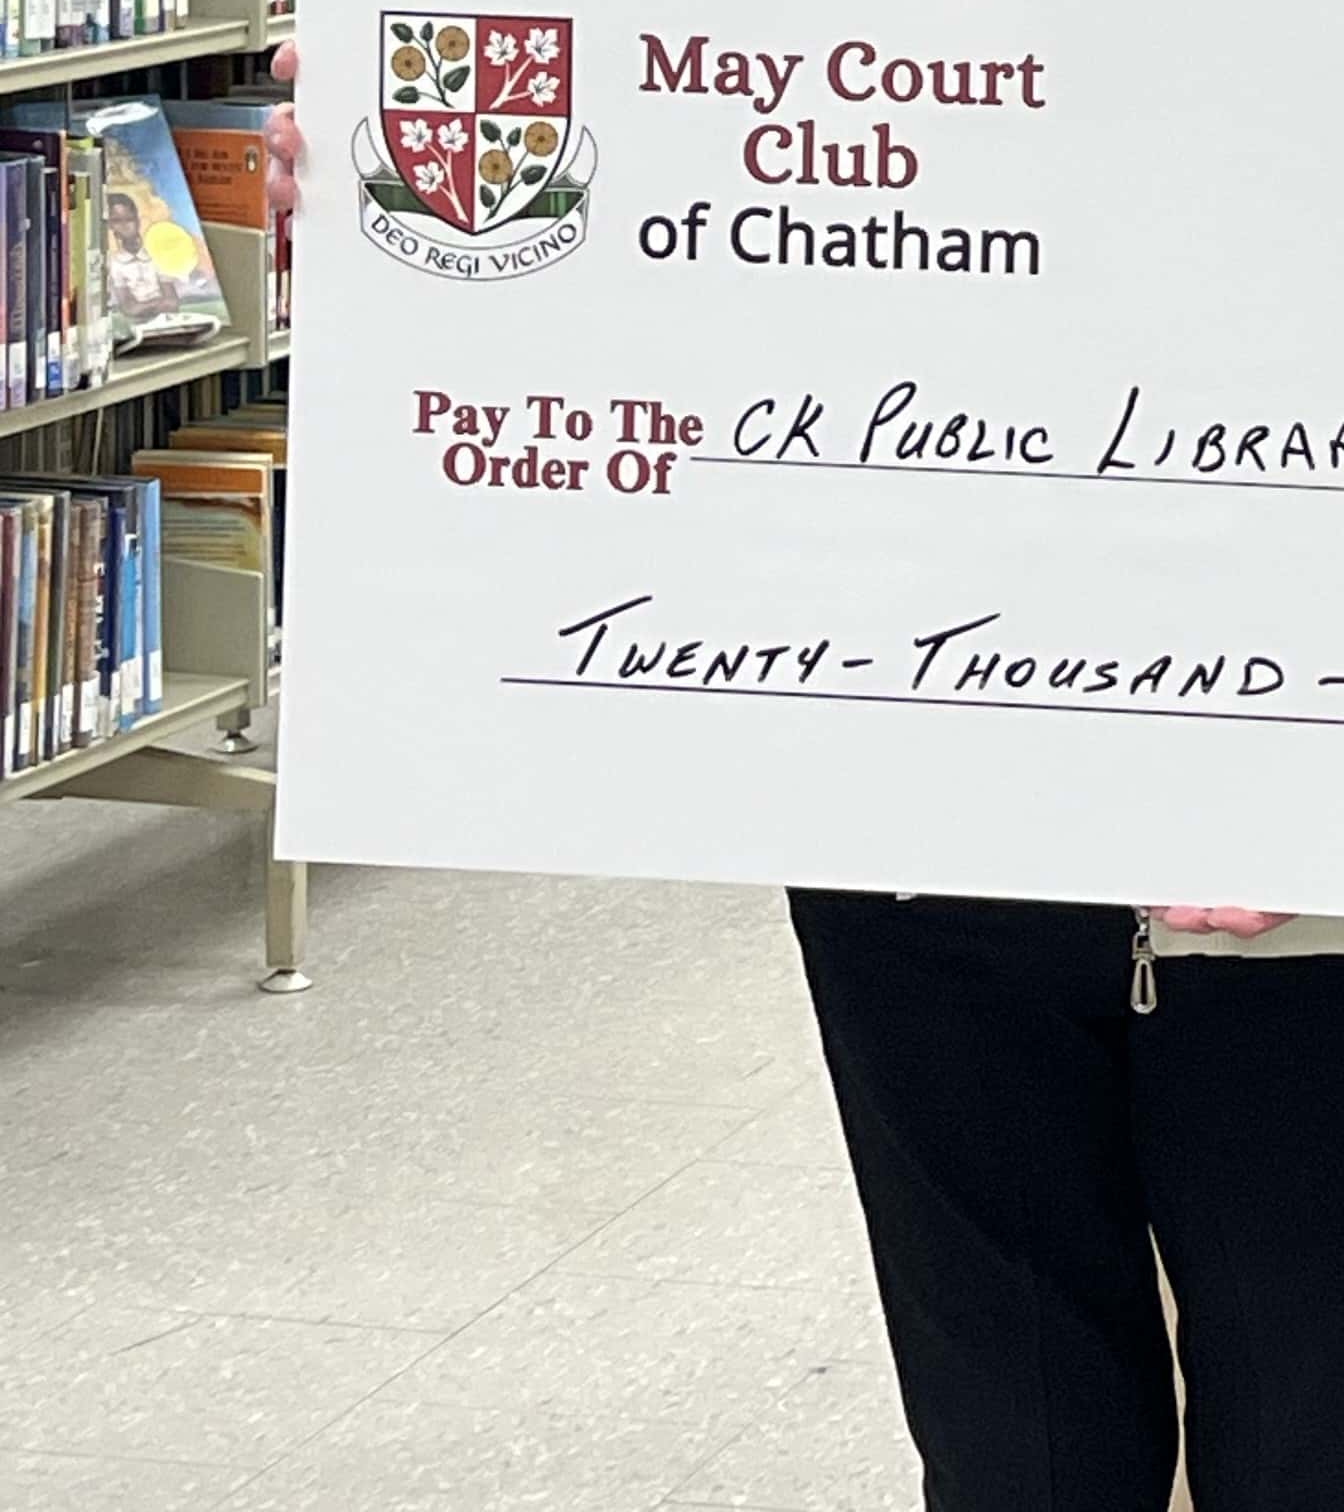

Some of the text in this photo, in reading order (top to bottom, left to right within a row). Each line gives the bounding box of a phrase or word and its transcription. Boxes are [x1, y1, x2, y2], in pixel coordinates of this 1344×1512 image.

[639, 33, 1046, 115] May Court
[743, 119, 919, 189] Club
[371, 214, 578, 277] DEO REGI VICINO
[638, 201, 1040, 275] of Chatham
[412, 390, 705, 447] Pay To The
[733, 393, 825, 460] CK
[859, 380, 1055, 464] PUBLIC
[443, 443, 678, 495] Order Of
